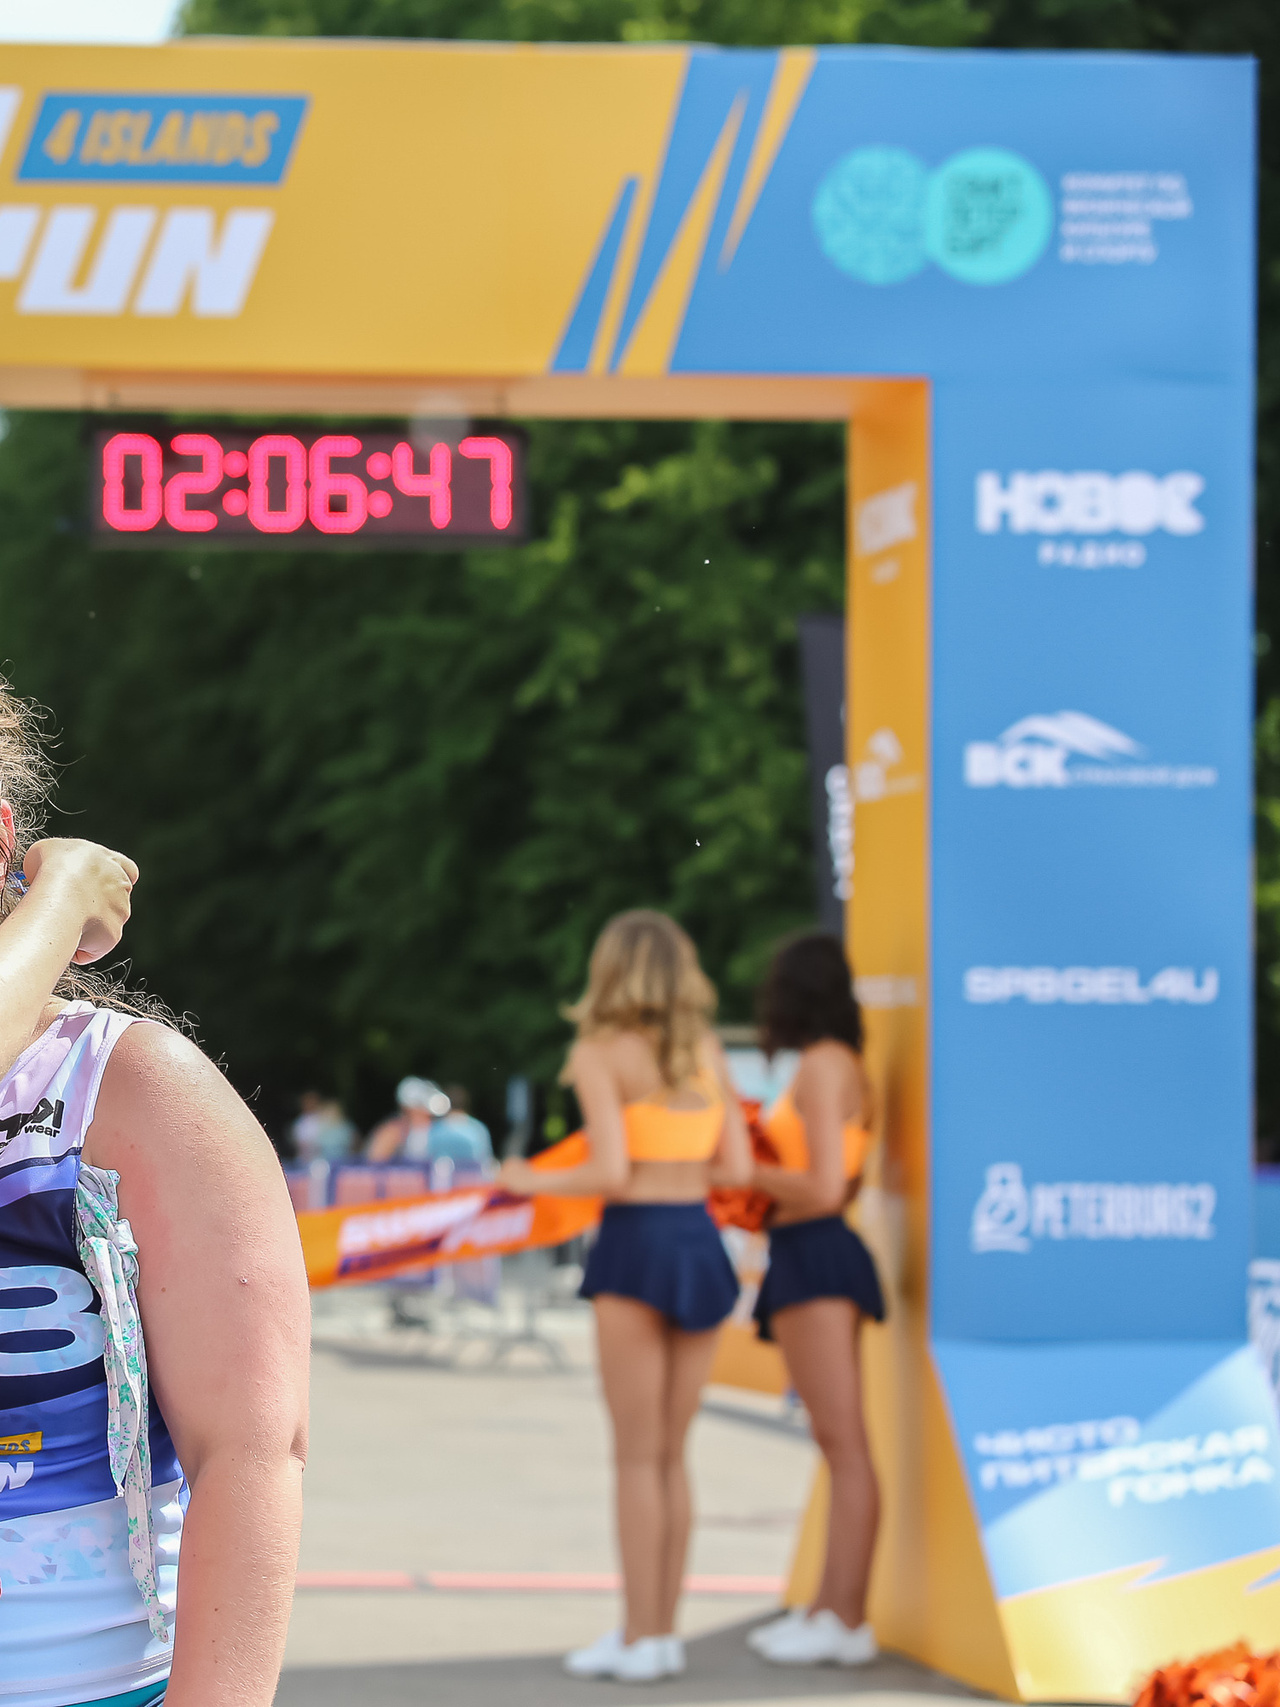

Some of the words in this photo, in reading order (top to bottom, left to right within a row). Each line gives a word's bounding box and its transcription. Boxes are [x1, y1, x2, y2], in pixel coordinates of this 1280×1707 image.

[42, 111, 82, 164] 4
[84, 110, 281, 166] ISLANDS
[103, 433, 513, 534] 02:06:47
